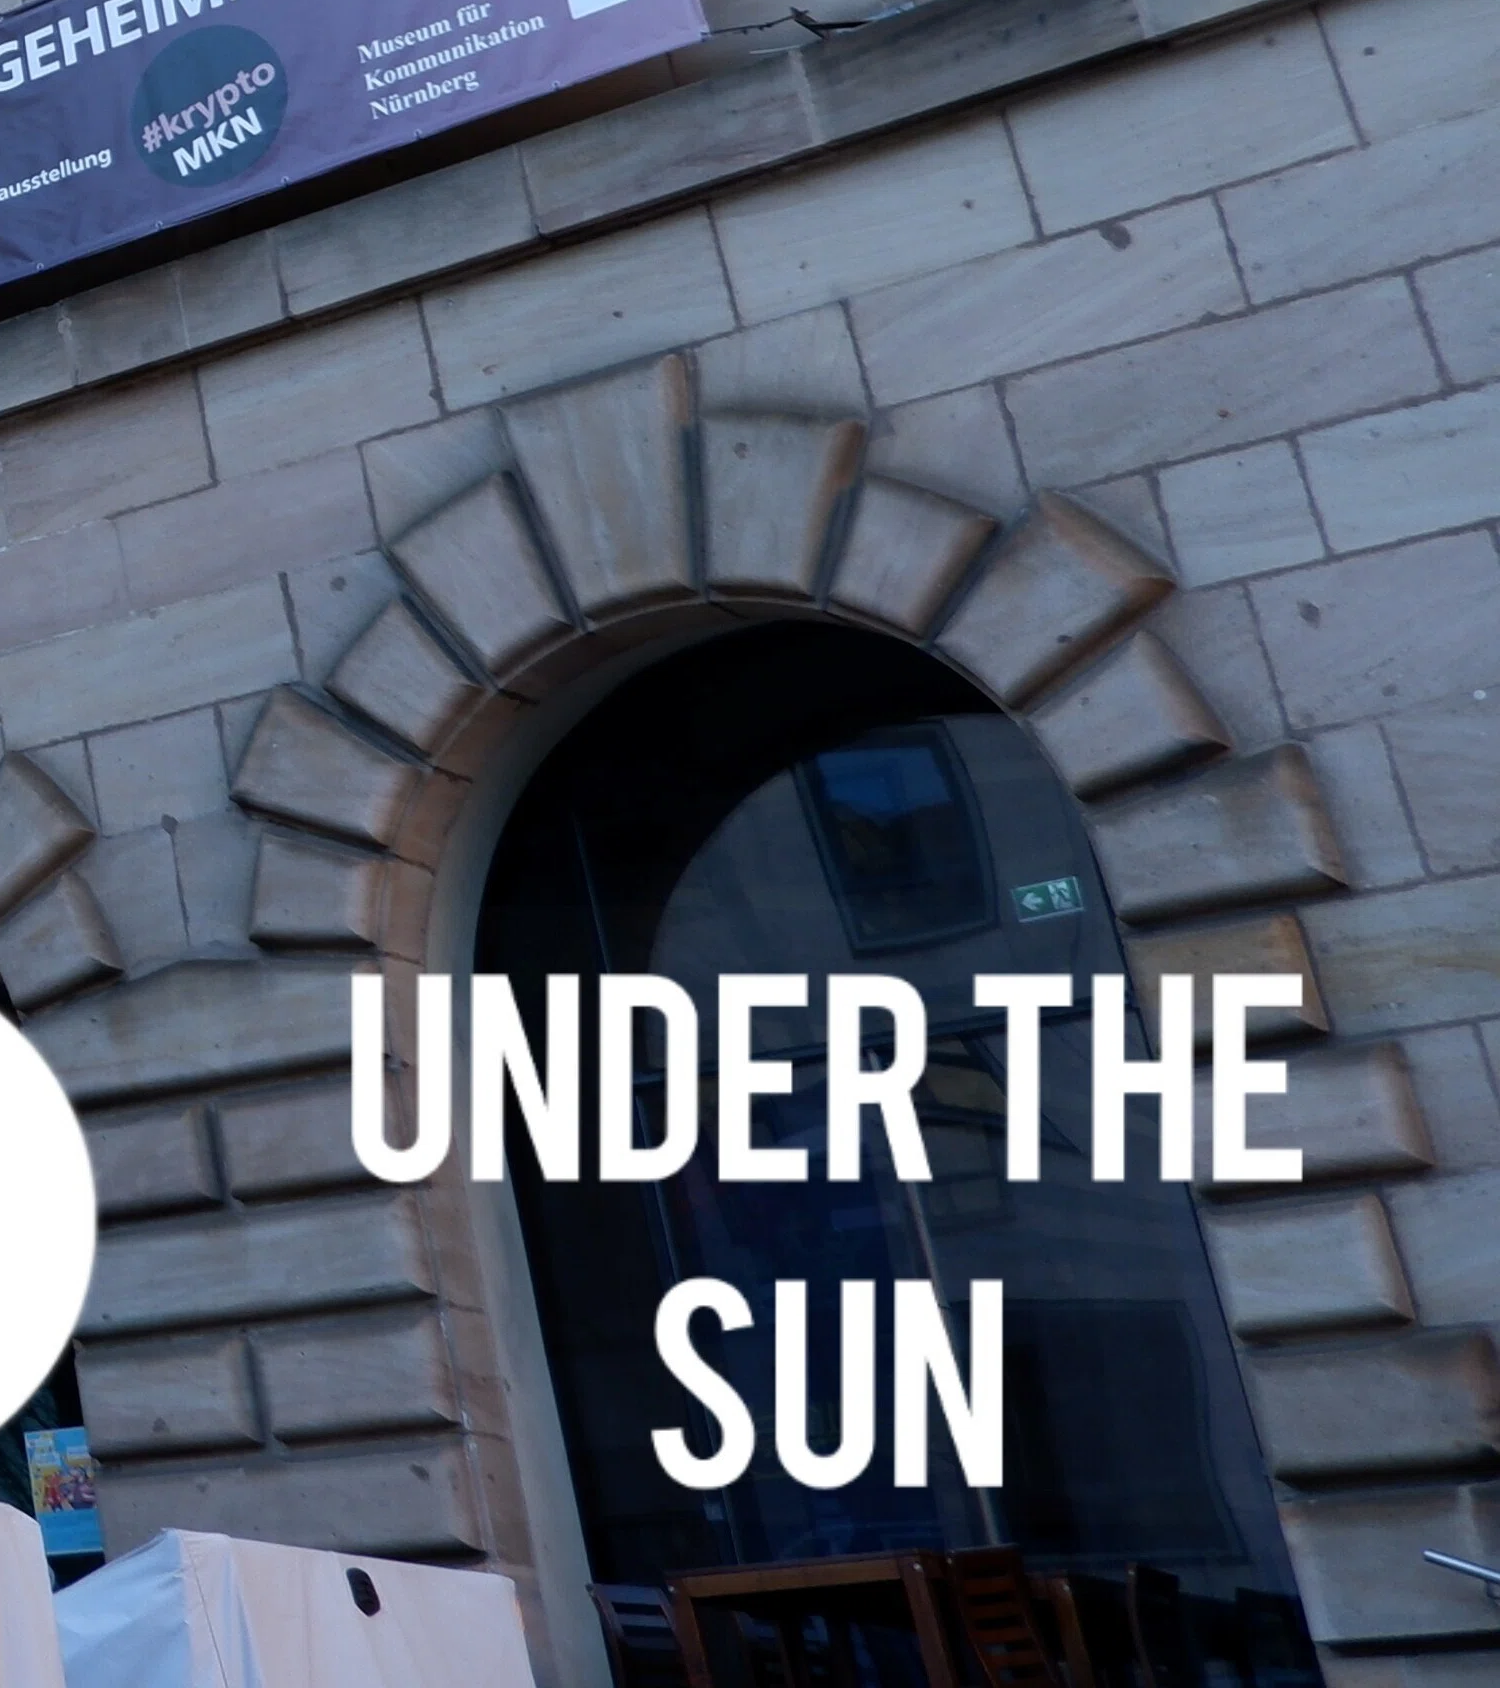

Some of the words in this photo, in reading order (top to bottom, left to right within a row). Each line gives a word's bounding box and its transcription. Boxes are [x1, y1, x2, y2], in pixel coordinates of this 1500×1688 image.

[356, 16, 453, 64] Museum
[456, 0, 493, 26] für
[363, 13, 546, 92] Kommunikation
[141, 61, 276, 154] #krypto
[369, 69, 480, 120] Nürnberg
[172, 107, 263, 177] MKN
